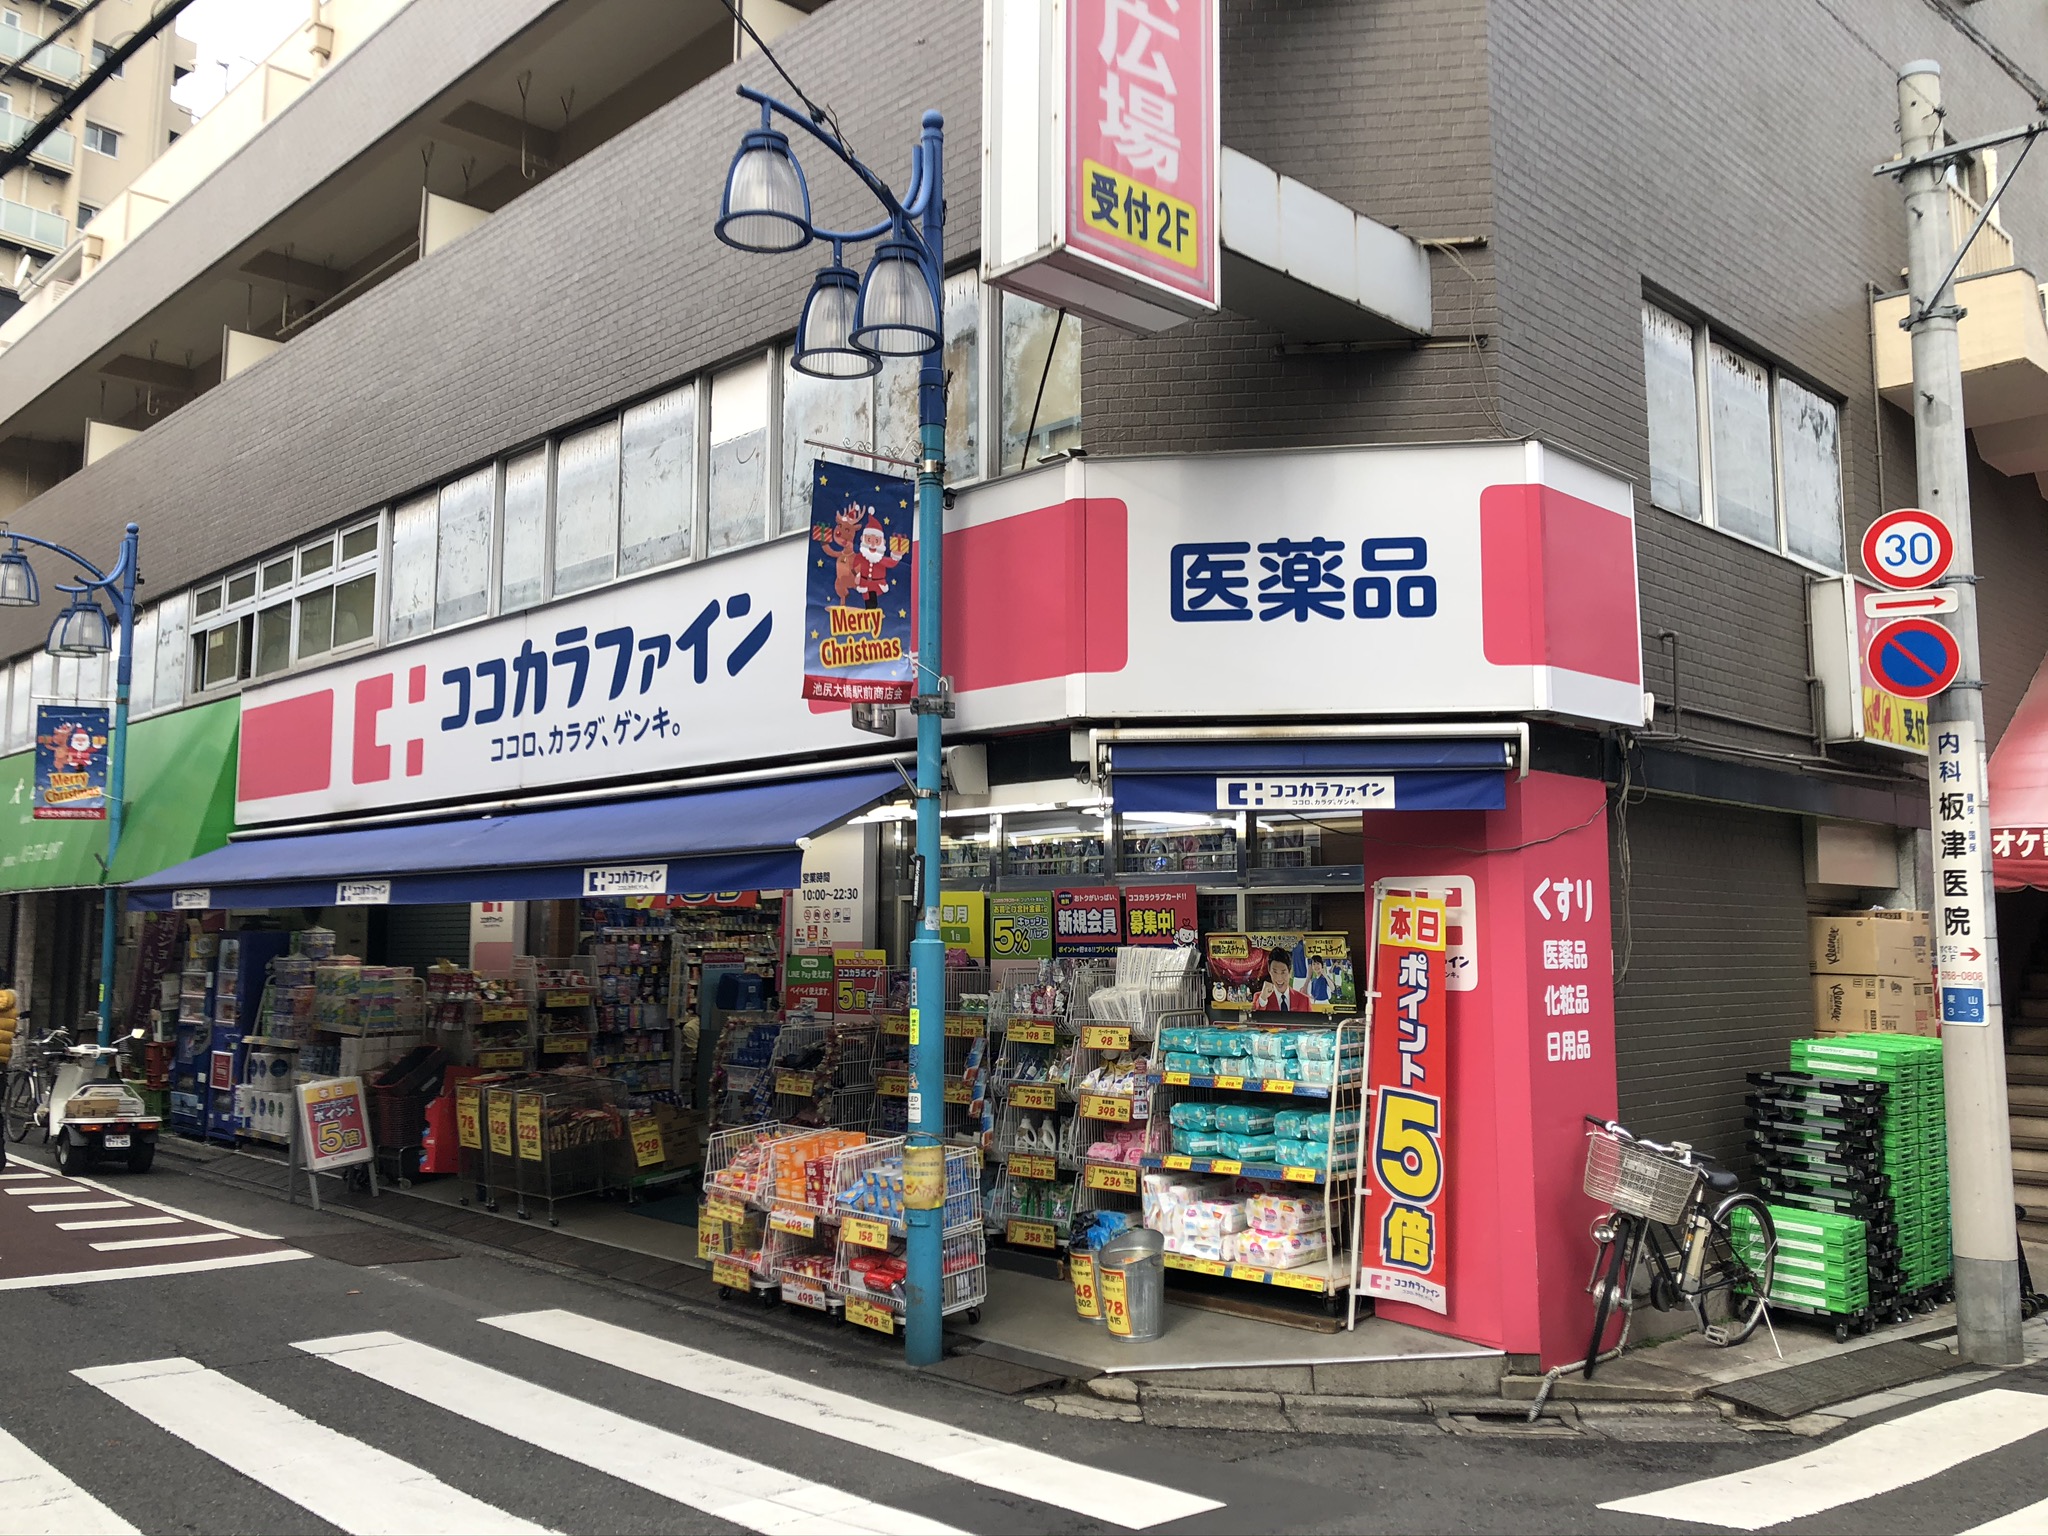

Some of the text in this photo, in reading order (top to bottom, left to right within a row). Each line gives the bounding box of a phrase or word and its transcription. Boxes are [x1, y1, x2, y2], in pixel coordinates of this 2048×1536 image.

[1091, 170, 1190, 253] 受付2F
[1884, 532, 1933, 567] 30
[1170, 536, 1437, 623] 医薬品
[831, 608, 884, 638] Merry
[820, 638, 902, 667] Christmas
[440, 592, 774, 732] ココカラファイン
[812, 681, 904, 701] 池尻大橋駅前商店会
[490, 706, 682, 762] ココロ、カラダ、ゲンキ。
[1938, 731, 1962, 783] 内科
[51, 773, 87, 788] Merry
[45, 788, 101, 804] Christmas
[1270, 782, 1386, 798] ココカラファイン
[1938, 792, 1971, 936] 板津医院
[608, 868, 663, 885] ココカラファイン
[803, 872, 831, 884] 営業時間
[1074, 894, 1118, 902] おトクがいっぱい、
[1128, 893, 1187, 901] ココカラクラブカード!!
[1533, 877, 1593, 923] くすり
[943, 905, 969, 923] 毎月
[1017, 916, 1048, 927] キャッシュ
[1057, 909, 1117, 935] 新規会員
[1129, 909, 1175, 936] 募集中!
[1390, 907, 1438, 942] 本日
[993, 917, 1031, 954] 5%
[1307, 944, 1344, 955] エスコートキッズ
[1825, 926, 1840, 965] Kleenex
[1543, 939, 1588, 970] 医薬品
[838, 969, 883, 978] ココカラポイント
[1544, 984, 1590, 1017] 化粧品
[1947, 995, 1978, 1004] 東山
[1399, 953, 1428, 1086] ポイント
[895, 1024, 909, 1033] 998
[1026, 1032, 1039, 1040] 198
[1101, 1036, 1113, 1046] 98
[1546, 1029, 1591, 1062] 日用品
[319, 1086, 343, 1097] 本日
[890, 1083, 905, 1093] 598
[1024, 1095, 1042, 1105] 798
[314, 1106, 355, 1121] ポイント
[1097, 1106, 1115, 1116] 398
[461, 1115, 474, 1128] 78
[520, 1124, 537, 1139] 228
[637, 1139, 659, 1153] 298
[1103, 1176, 1121, 1187] 236
[1374, 1088, 1444, 1270] 5倍
[785, 1220, 802, 1231] 498
[858, 1230, 873, 1242] 158
[1024, 1233, 1041, 1243] 358
[1074, 1284, 1092, 1299] 48
[1394, 1278, 1440, 1299] ココカラファイン
[797, 1294, 814, 1305] 498
[1104, 1298, 1124, 1316] 78
[863, 1313, 879, 1326] 298
